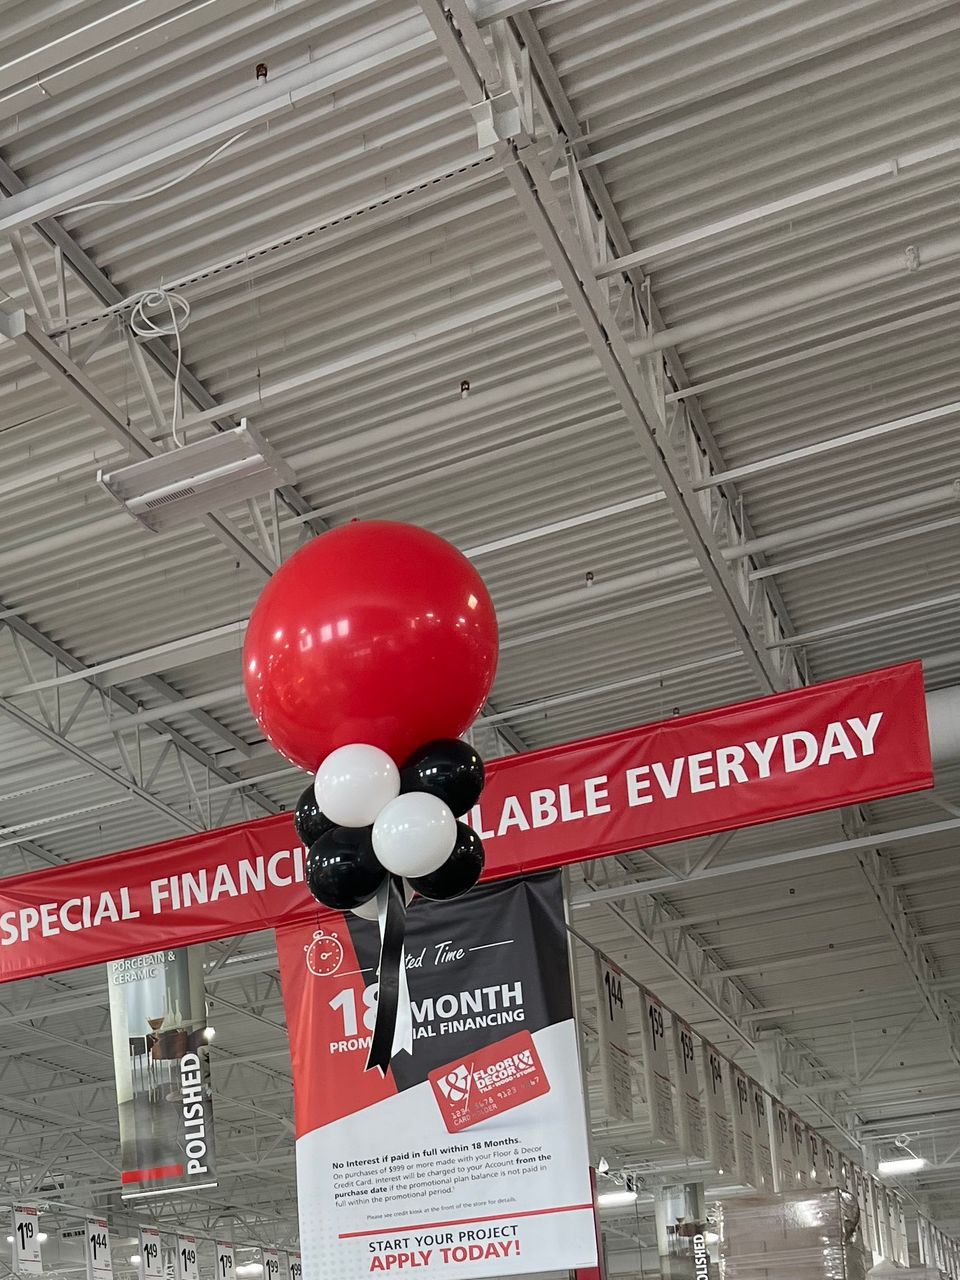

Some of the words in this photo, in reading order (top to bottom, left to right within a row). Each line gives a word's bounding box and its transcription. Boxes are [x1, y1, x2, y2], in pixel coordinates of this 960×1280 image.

[0, 887, 140, 946] SPECIAL
[150, 846, 308, 915] FINANCI
[471, 775, 611, 841] LABLE
[626, 712, 884, 808] EVERYDAY
[112, 952, 166, 974] PORCELAIN
[167, 951, 177, 962] &
[435, 940, 466, 966] Time
[112, 967, 157, 985] CERAMIC
[411, 981, 524, 1024] MONTH
[440, 1009, 525, 1036] FINANCING
[473, 1057, 515, 1080] FLOOR
[476, 1066, 517, 1089] DECOR
[180, 1053, 208, 1175] POLISHED
[345, 1169, 378, 1181] purchases
[388, 1164, 405, 1173] $999
[415, 1160, 434, 1169] more
[436, 1157, 456, 1166] made
[457, 1154, 474, 1163] with
[475, 1153, 491, 1163] your
[493, 1149, 511, 1158] Floor
[521, 1145, 543, 1154] Decor
[346, 1157, 380, 1168] Interest
[390, 1152, 409, 1163] paid
[412, 1151, 420, 1159] in
[422, 1148, 438, 1157] full
[439, 1144, 469, 1155] within
[471, 1142, 482, 1150] 18
[334, 1180, 354, 1189] Credit
[403, 1172, 415, 1180] will
[427, 1166, 456, 1178] charged
[466, 1164, 482, 1174] your
[485, 1159, 514, 1170] Account
[515, 1156, 536, 1165] from
[538, 1153, 552, 1161] the
[334, 1188, 368, 1200] purchase
[370, 1186, 388, 1194] date
[395, 1183, 408, 1191] the
[409, 1176, 452, 1192] promotional
[453, 1174, 469, 1184] plan
[471, 1170, 499, 1181] balance
[507, 1168, 521, 1176] not
[522, 1165, 539, 1175] paid
[335, 1199, 346, 1208] full
[347, 1197, 370, 1206] within
[371, 1196, 383, 1204] the
[384, 1190, 427, 1203] promotional
[368, 1238, 410, 1253] START
[415, 1233, 454, 1246] YOUR
[459, 1225, 518, 1242] PROJECT
[369, 1249, 433, 1272] APPLY
[440, 1239, 521, 1264] TODAY!
